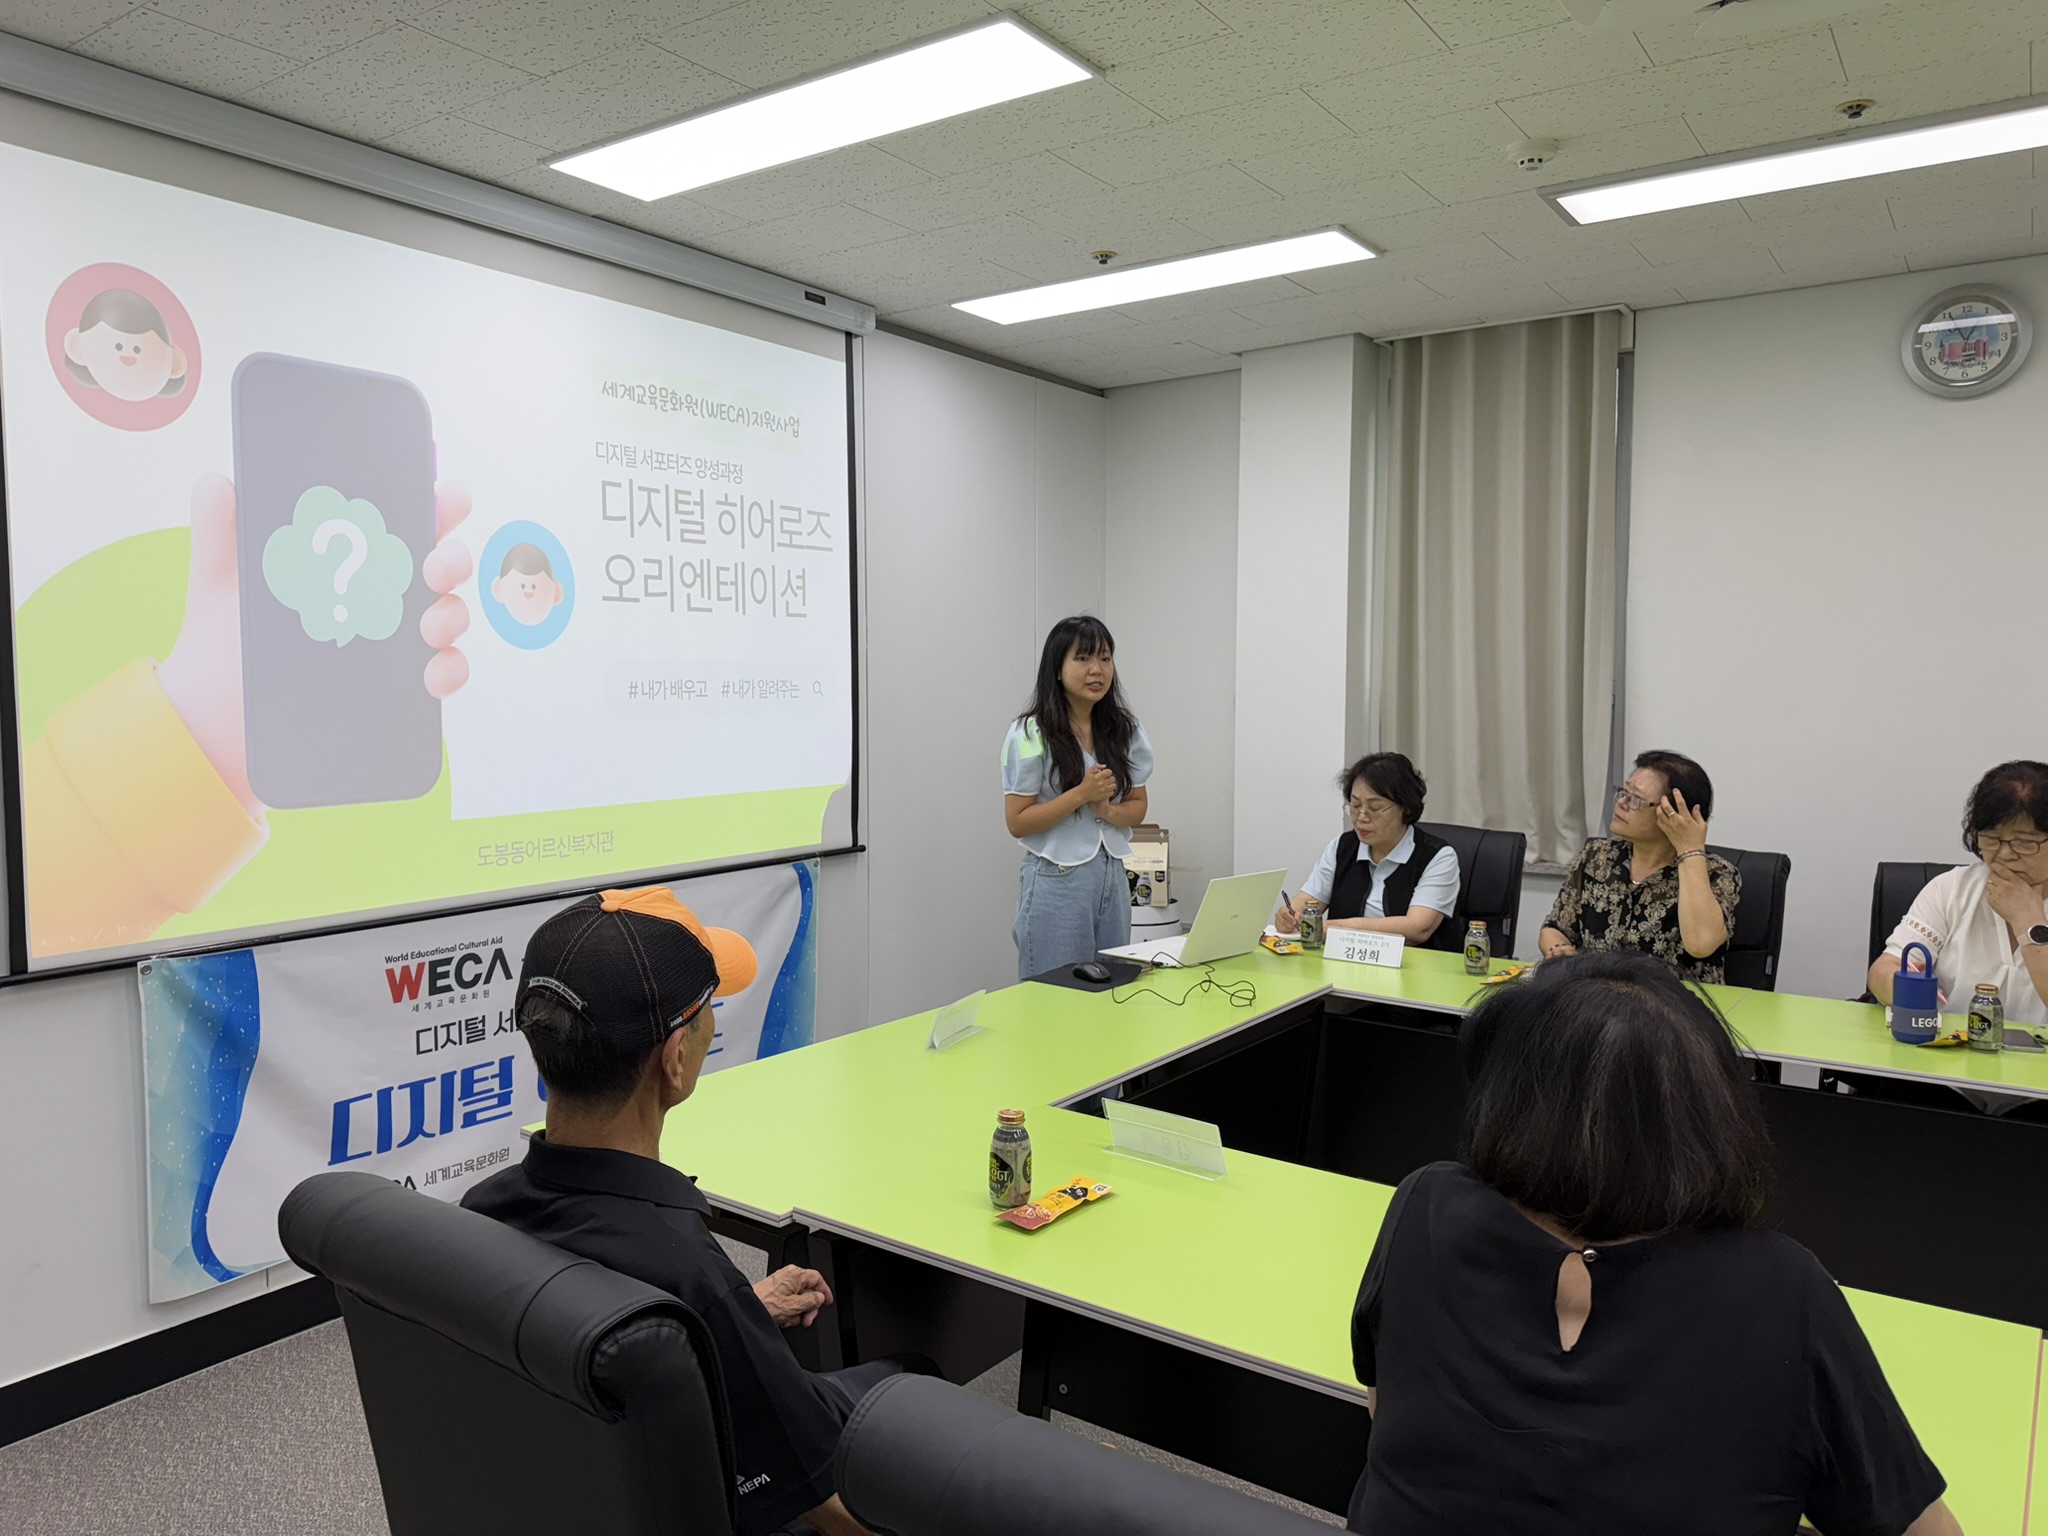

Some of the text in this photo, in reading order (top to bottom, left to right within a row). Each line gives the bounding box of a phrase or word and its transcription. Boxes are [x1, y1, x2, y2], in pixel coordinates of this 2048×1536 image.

[1962, 305, 1973, 313] 12
[1924, 341, 1931, 350] 9
[2001, 332, 2008, 341] 3
[1929, 357, 1936, 366] 8
[1943, 367, 1949, 376] 7
[1981, 363, 1988, 372] 5
[1961, 369, 1968, 378] 6
[601, 380, 800, 438] 세계교육문화원(WECA)지원사업
[595, 441, 743, 484] 디지털 서포터즈 양성과정
[601, 478, 834, 553] 디지털 히어로즈
[602, 553, 808, 618] 오리엔테이션
[670, 679, 708, 700] 배우고
[757, 678, 800, 699] 알려주는
[477, 829, 615, 866] 도봉동어르신복지관
[385, 936, 503, 964] World Educational Cultural Aid
[1344, 946, 1380, 963] 김성희
[385, 947, 513, 1004] WECA
[416, 1008, 520, 1056] 디지털 서
[327, 1055, 515, 1166] 디지털
[424, 1147, 510, 1187] 세계교육문화원
[738, 1473, 771, 1495] NEPA
